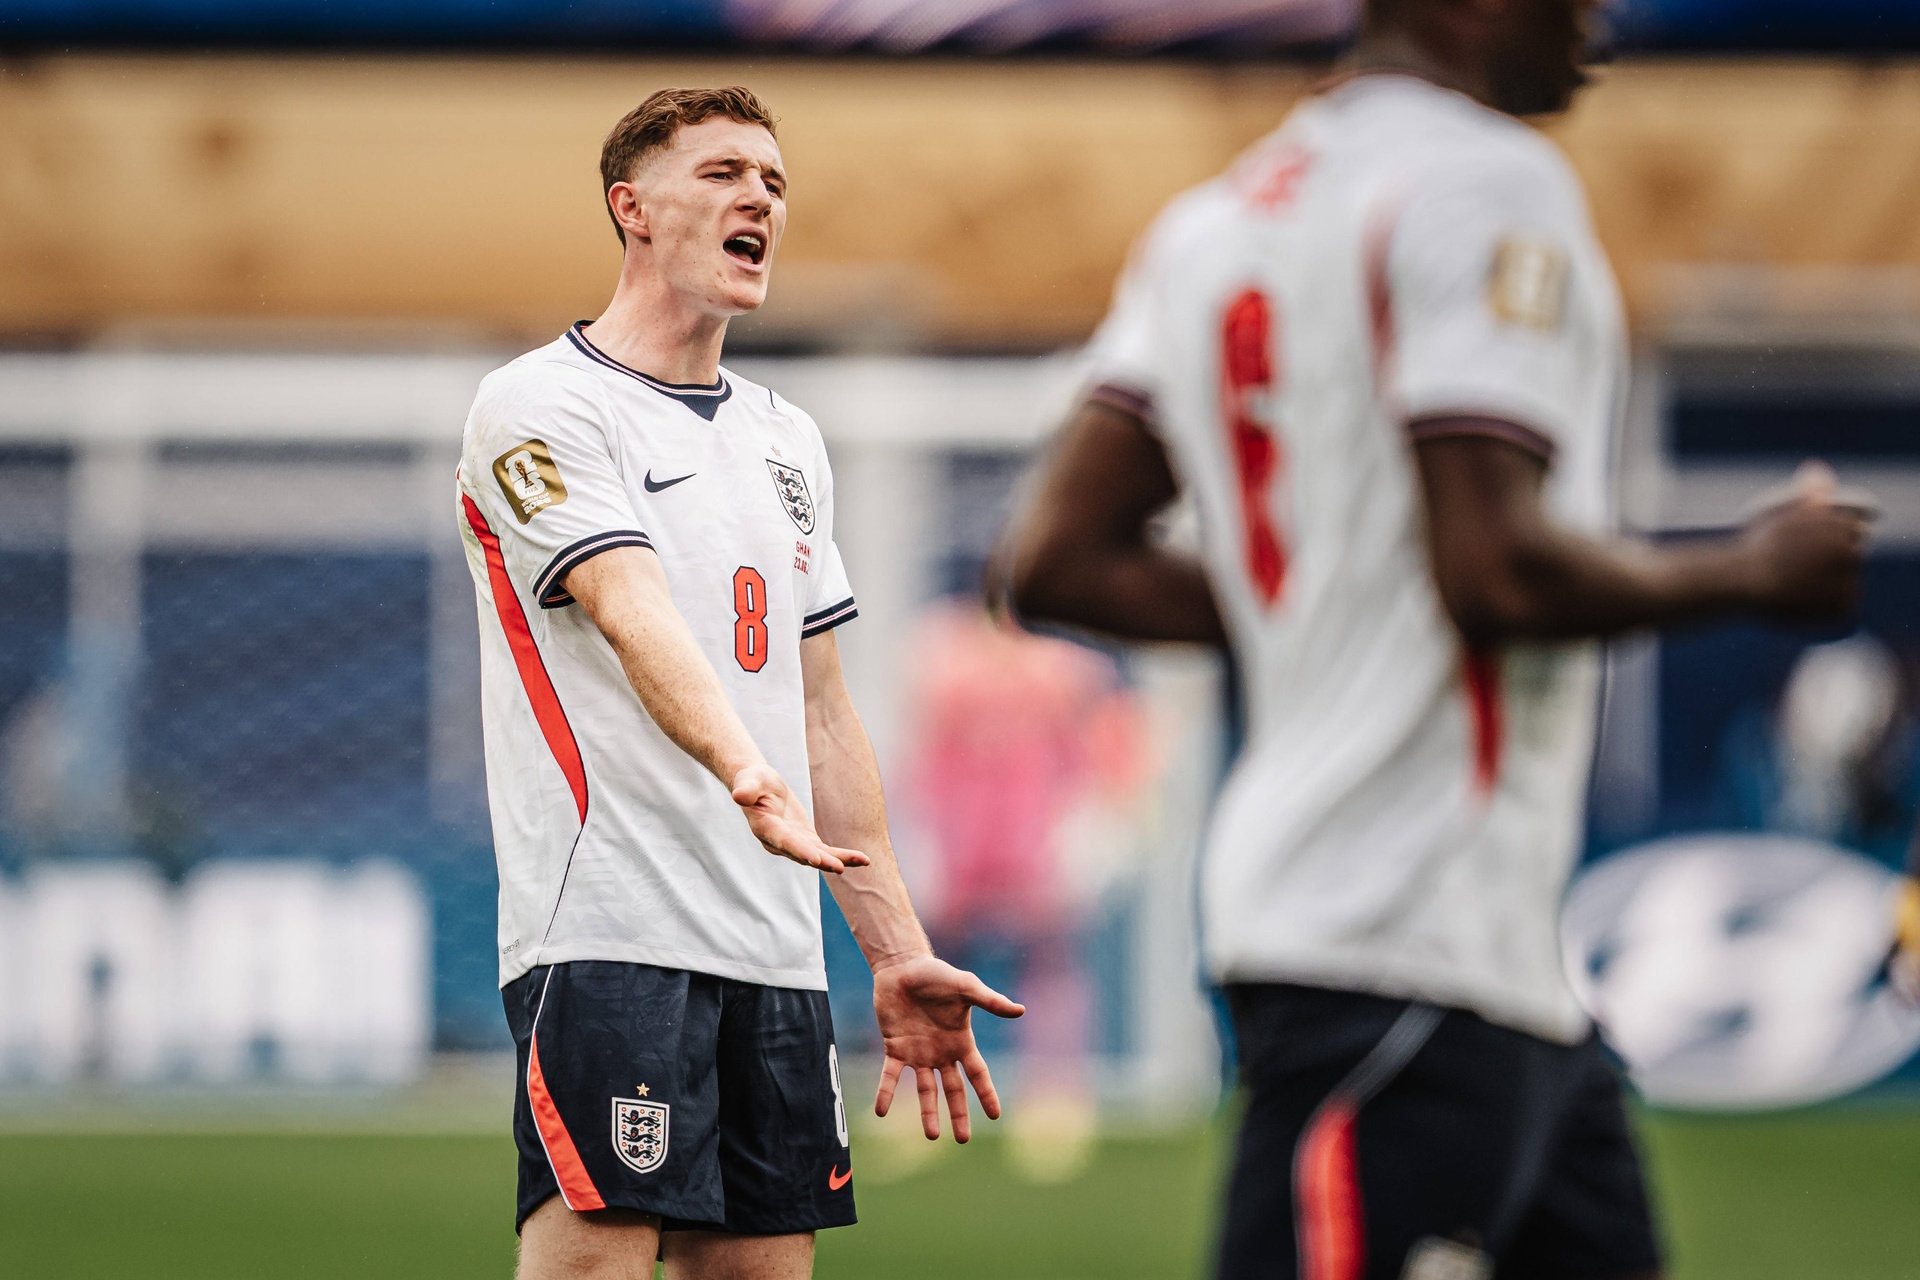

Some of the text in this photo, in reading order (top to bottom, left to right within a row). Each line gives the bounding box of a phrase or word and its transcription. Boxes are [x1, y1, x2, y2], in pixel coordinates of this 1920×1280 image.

[796, 541, 811, 558] GHAN
[733, 566, 768, 673] 8
[828, 1043, 849, 1148] 8
